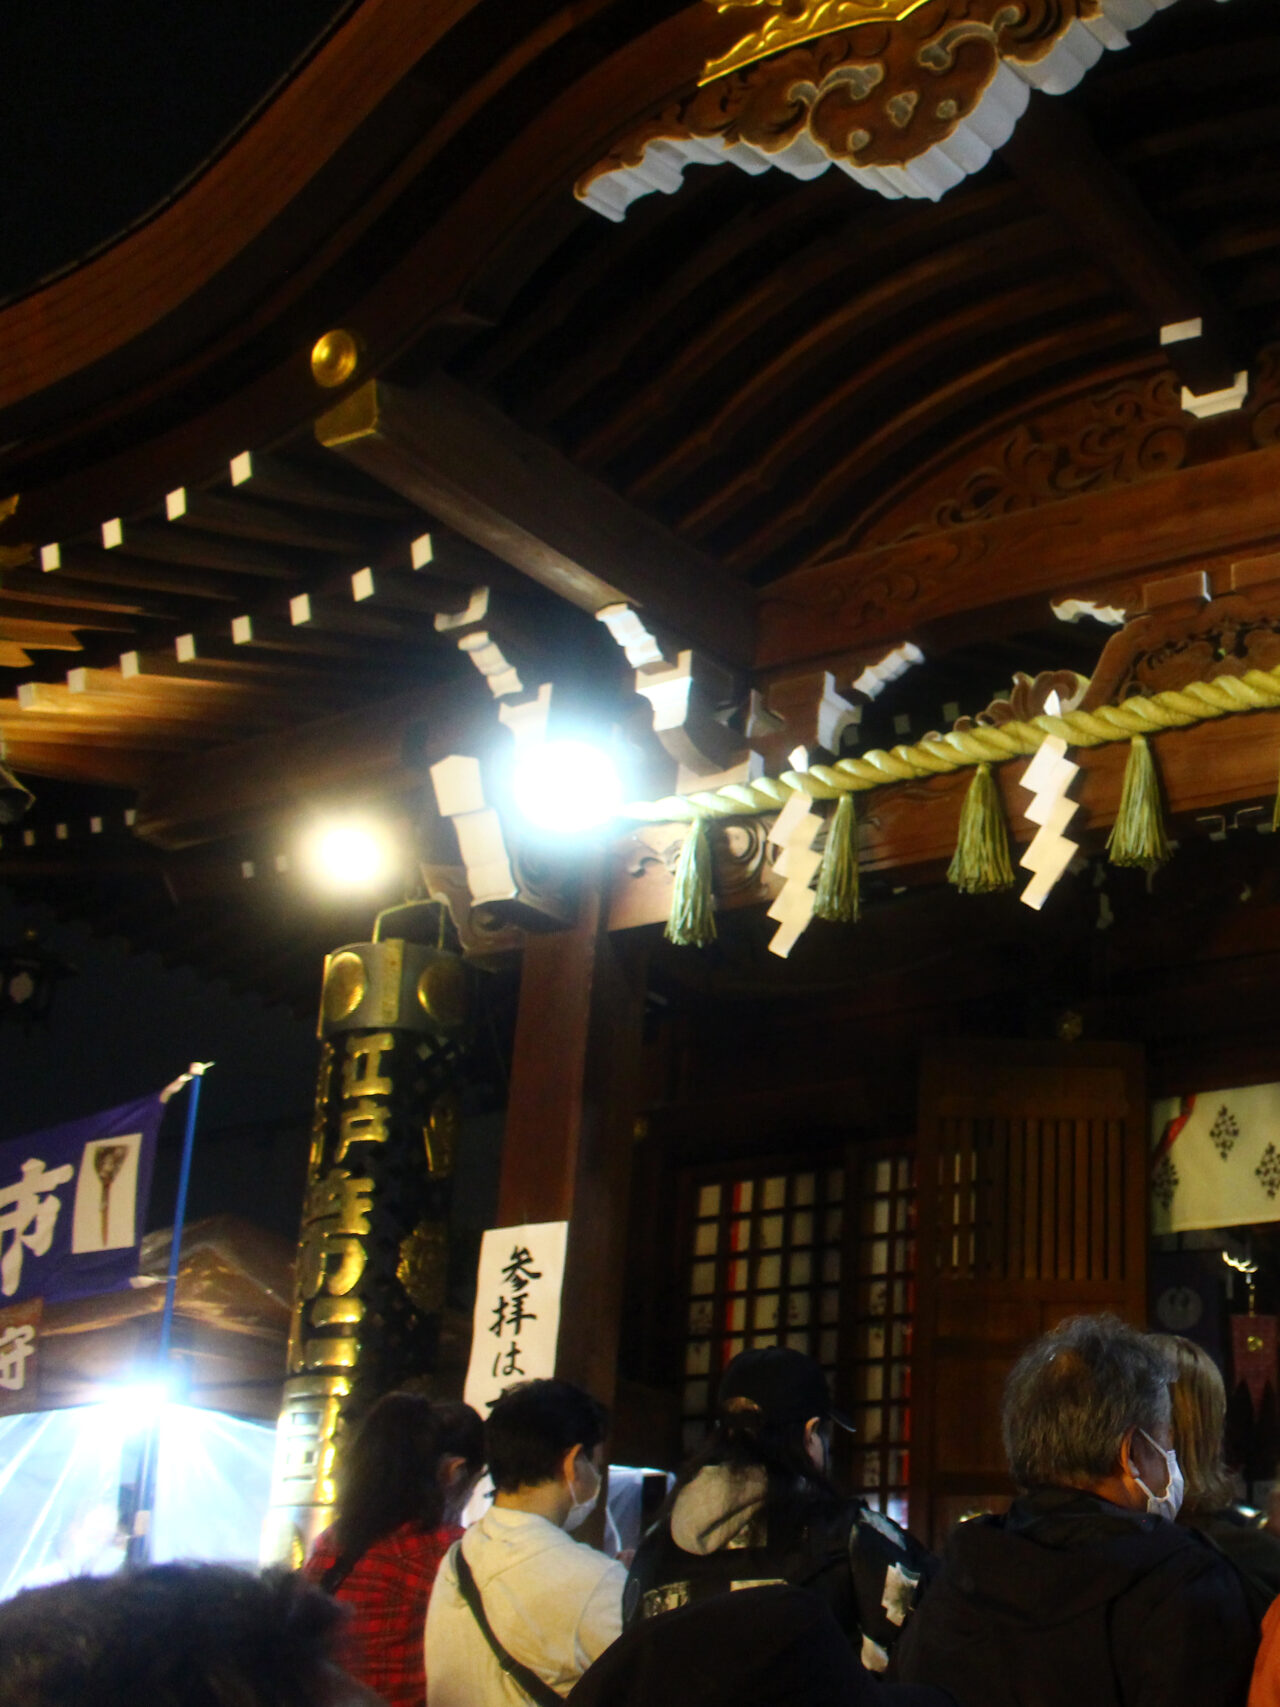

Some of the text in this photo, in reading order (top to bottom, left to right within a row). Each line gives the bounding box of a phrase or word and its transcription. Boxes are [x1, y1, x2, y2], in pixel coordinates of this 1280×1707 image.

[334, 1031, 395, 1164] 江戸
[486, 1245, 542, 1410] 参拝は
